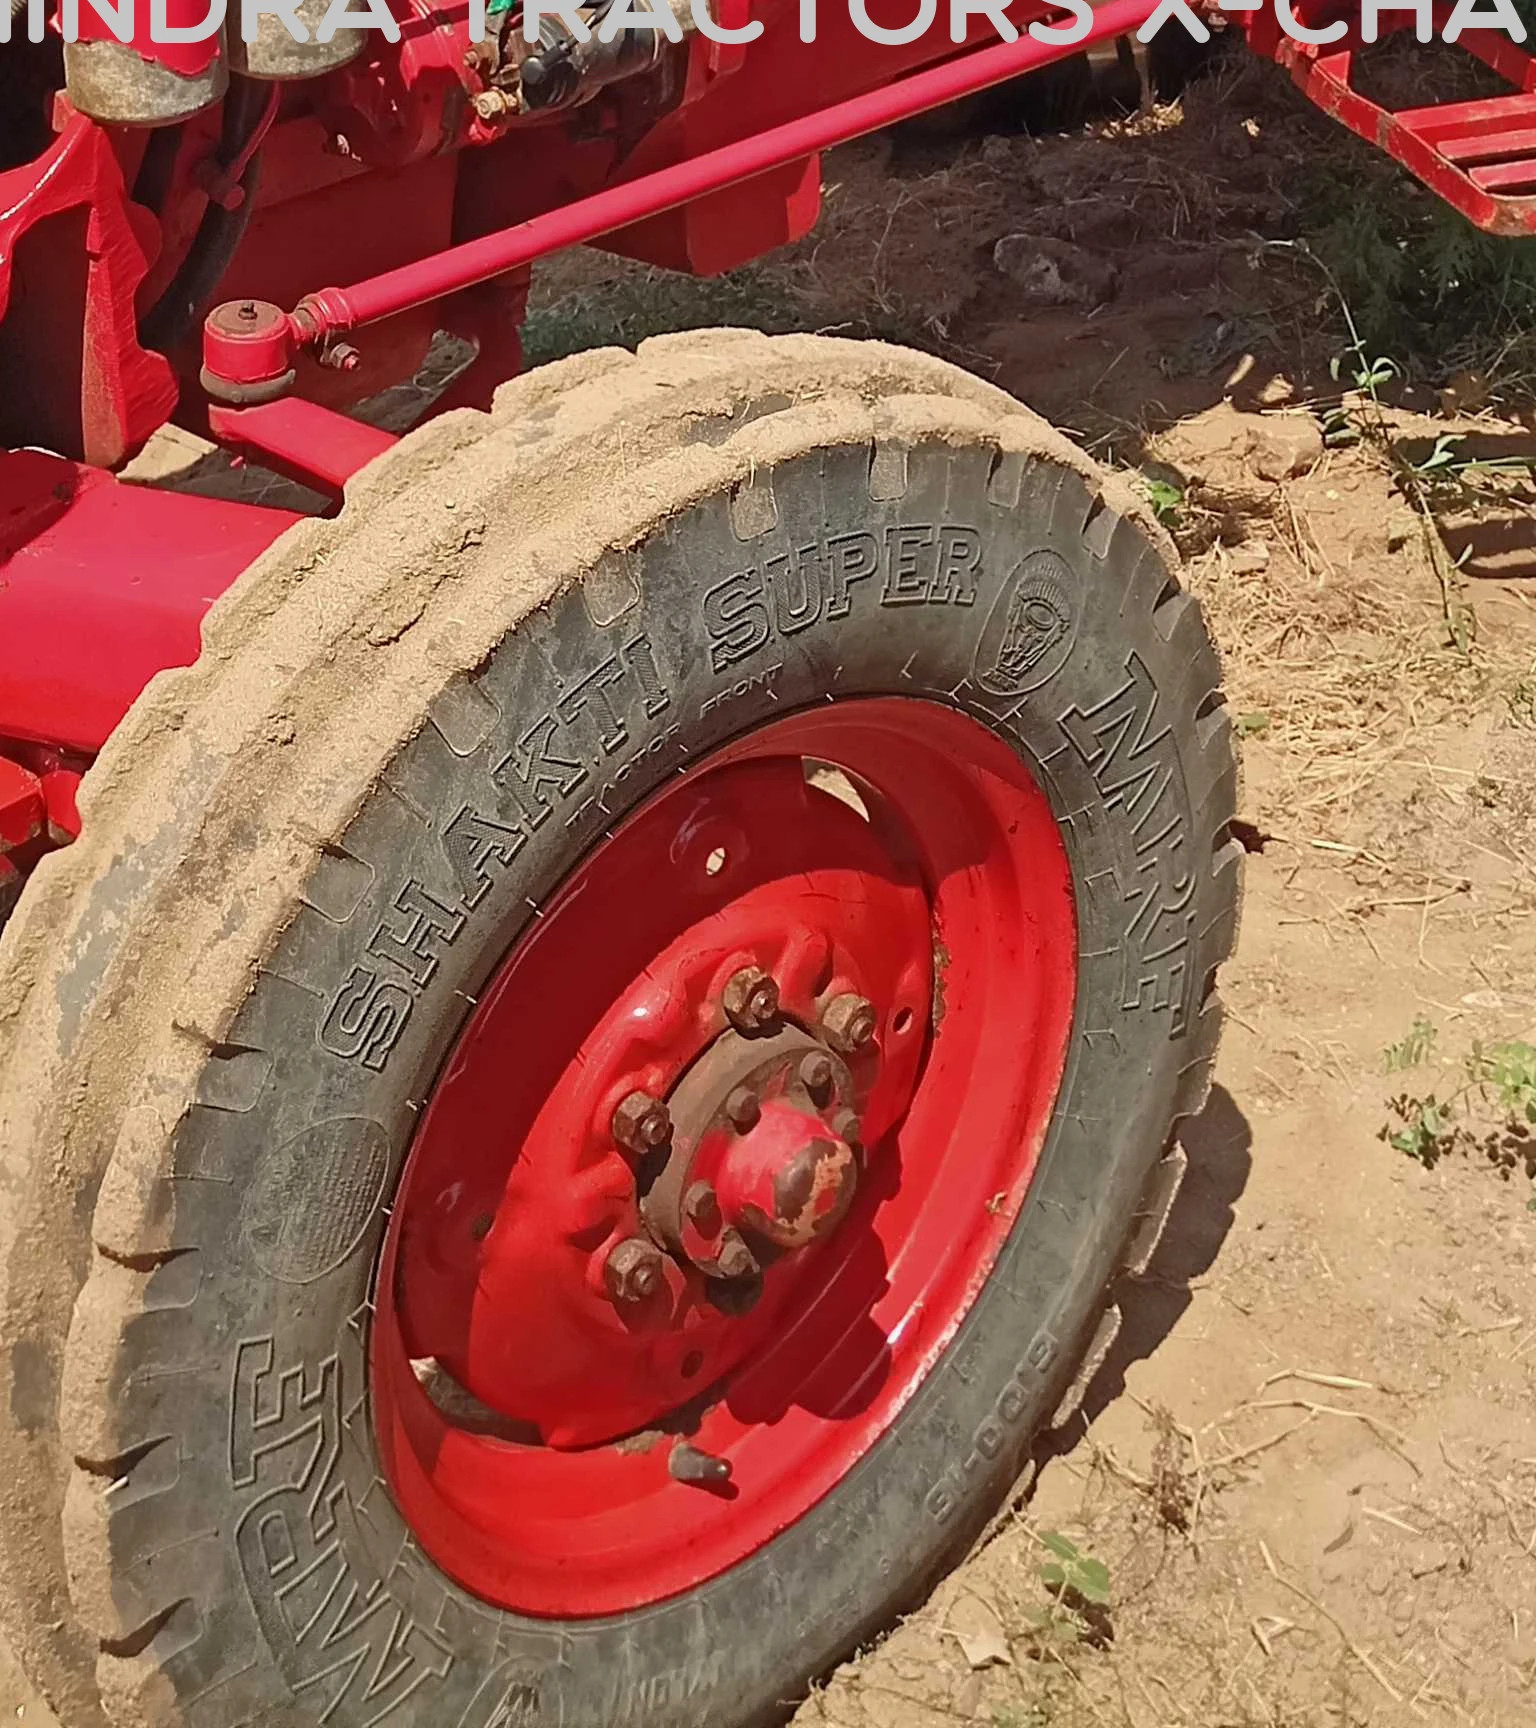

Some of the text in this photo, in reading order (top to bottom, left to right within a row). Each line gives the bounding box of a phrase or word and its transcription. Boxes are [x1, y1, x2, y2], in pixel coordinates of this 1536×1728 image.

[319, 522, 982, 1070] SHAKTI SUPER
[699, 662, 784, 720] FRONT
[1057, 648, 1199, 1040] MRF
[228, 1334, 456, 1728] MRF
